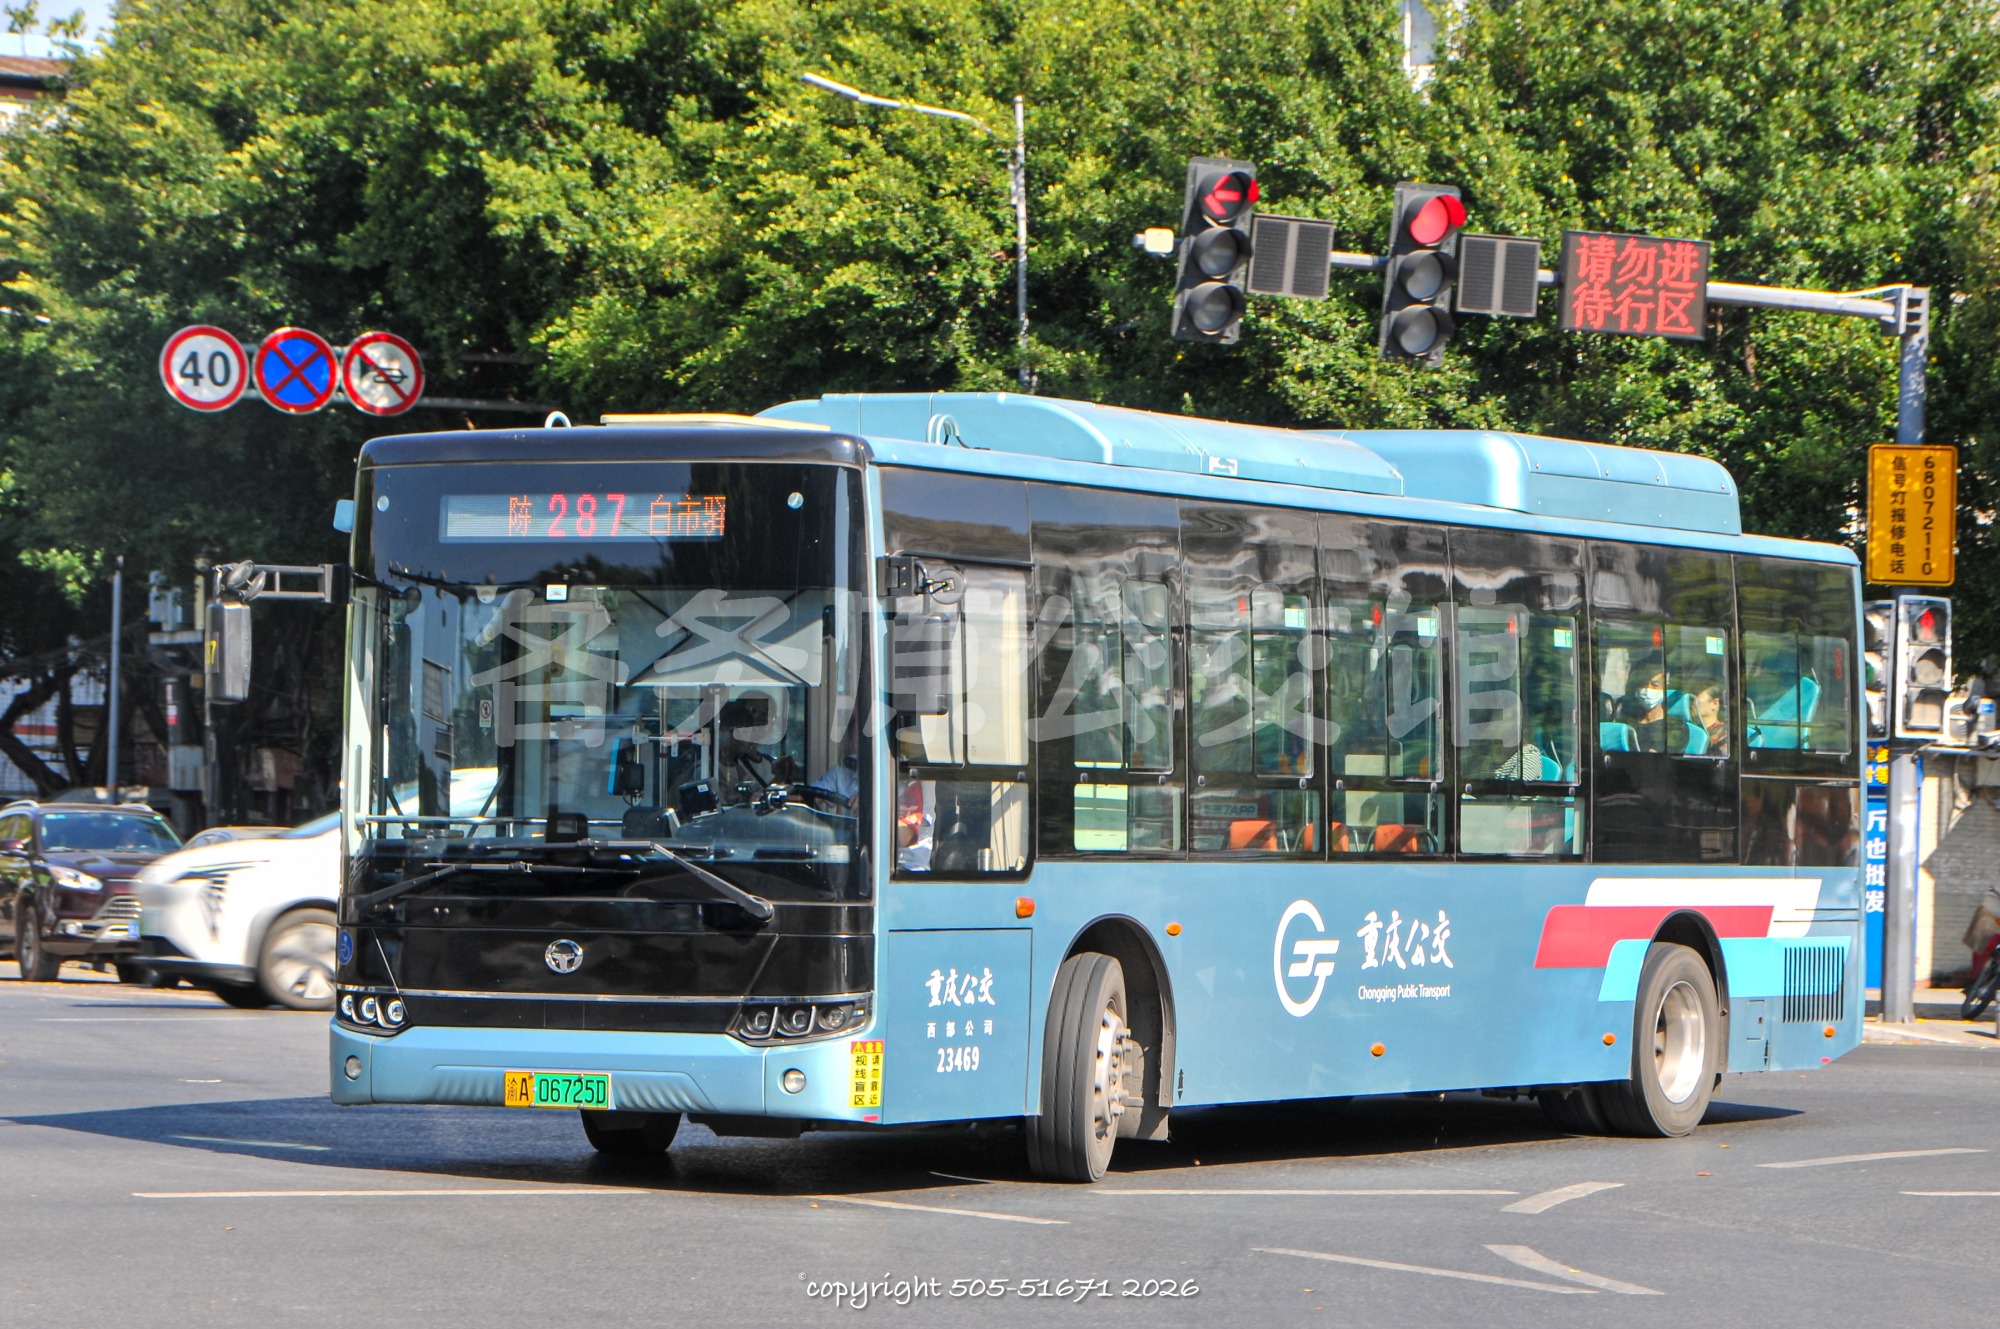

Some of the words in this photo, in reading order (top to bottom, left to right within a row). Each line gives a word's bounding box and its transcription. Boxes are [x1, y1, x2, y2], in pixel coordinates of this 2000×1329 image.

[1576, 235, 1699, 289] 请勿进
[1572, 281, 1695, 333] 待行区
[180, 350, 231, 387] 40
[548, 494, 625, 537] 287
[650, 494, 726, 536] 白市驿
[1890, 456, 1907, 574] 信号灯报修电话
[1921, 456, 1935, 575] 68072110
[1356, 909, 1454, 970] 重庆公交
[925, 968, 996, 1007] 重庆公交
[1358, 985, 1396, 1003] Chongqing
[1397, 984, 1418, 999] Public
[1418, 984, 1451, 1000] Transport
[927, 1019, 993, 1038] 西部公司
[854, 1055, 867, 1105] 视线盲区
[936, 1046, 980, 1073] 23469
